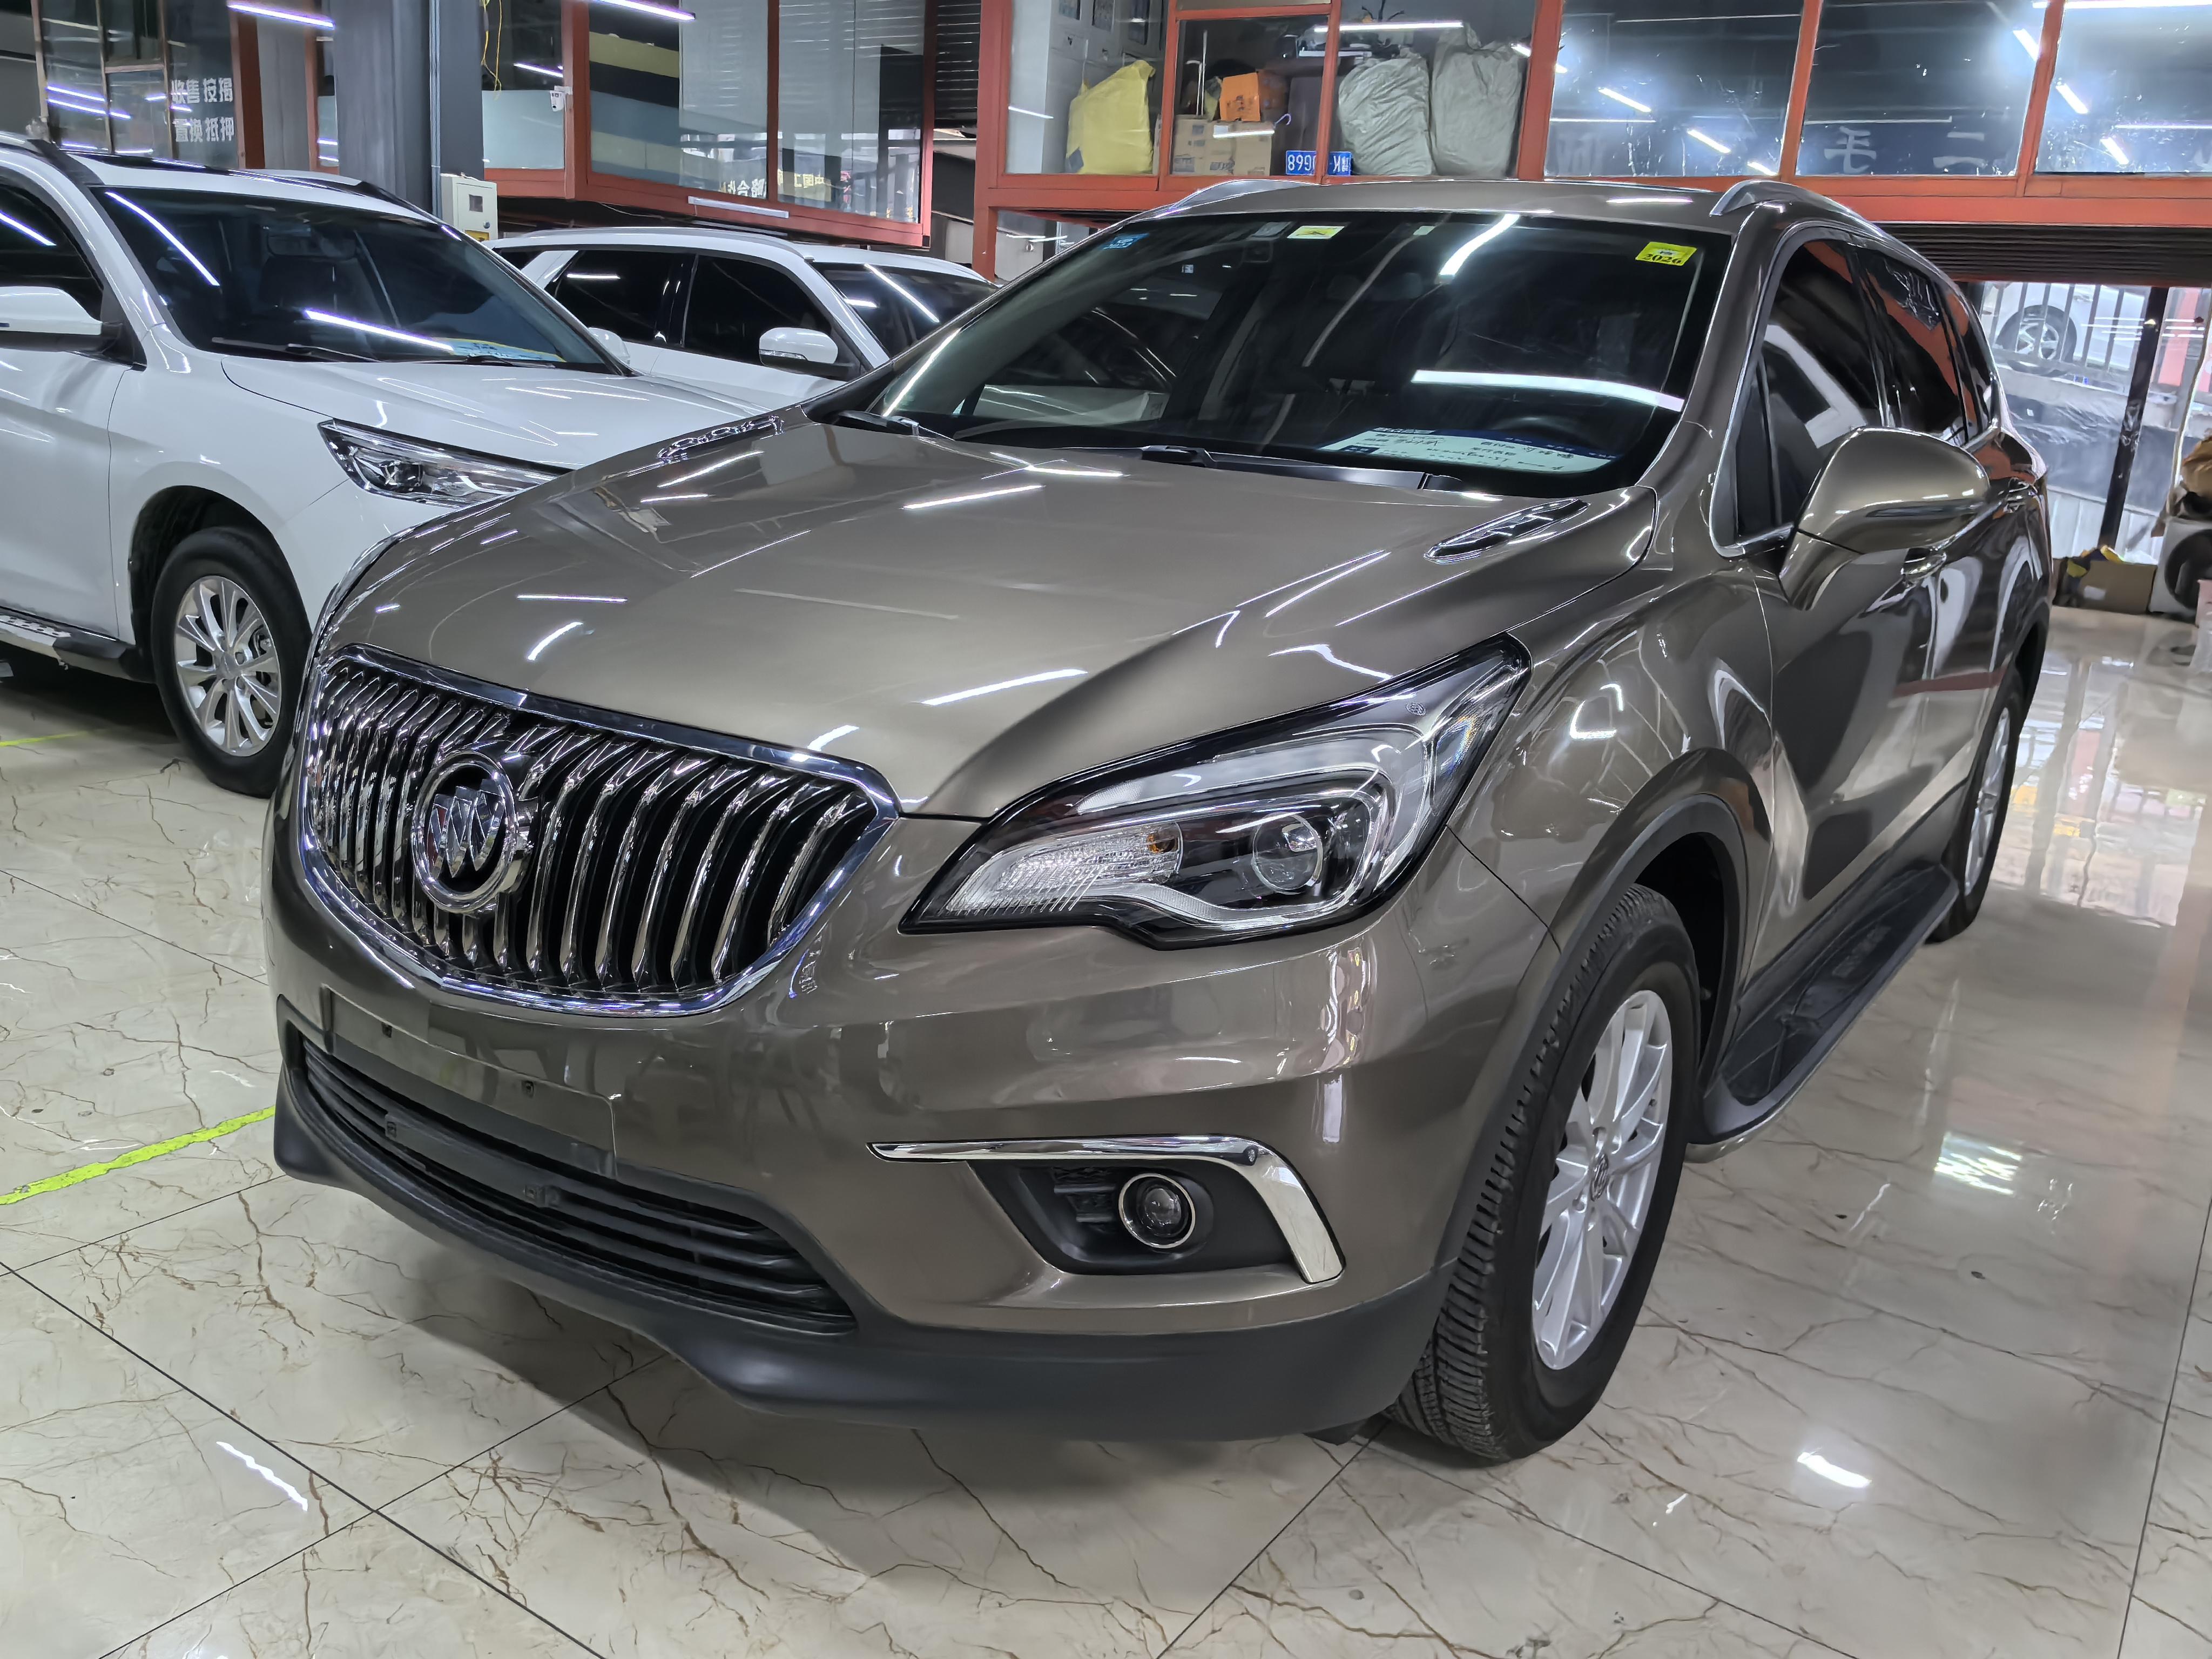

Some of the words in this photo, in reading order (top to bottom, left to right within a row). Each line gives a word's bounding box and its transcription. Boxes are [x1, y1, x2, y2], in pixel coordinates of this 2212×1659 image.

[203, 78, 233, 102] 按揭
[173, 118, 203, 143] 置换
[205, 117, 234, 141] 抵押
[1642, 253, 1683, 264] 2026
